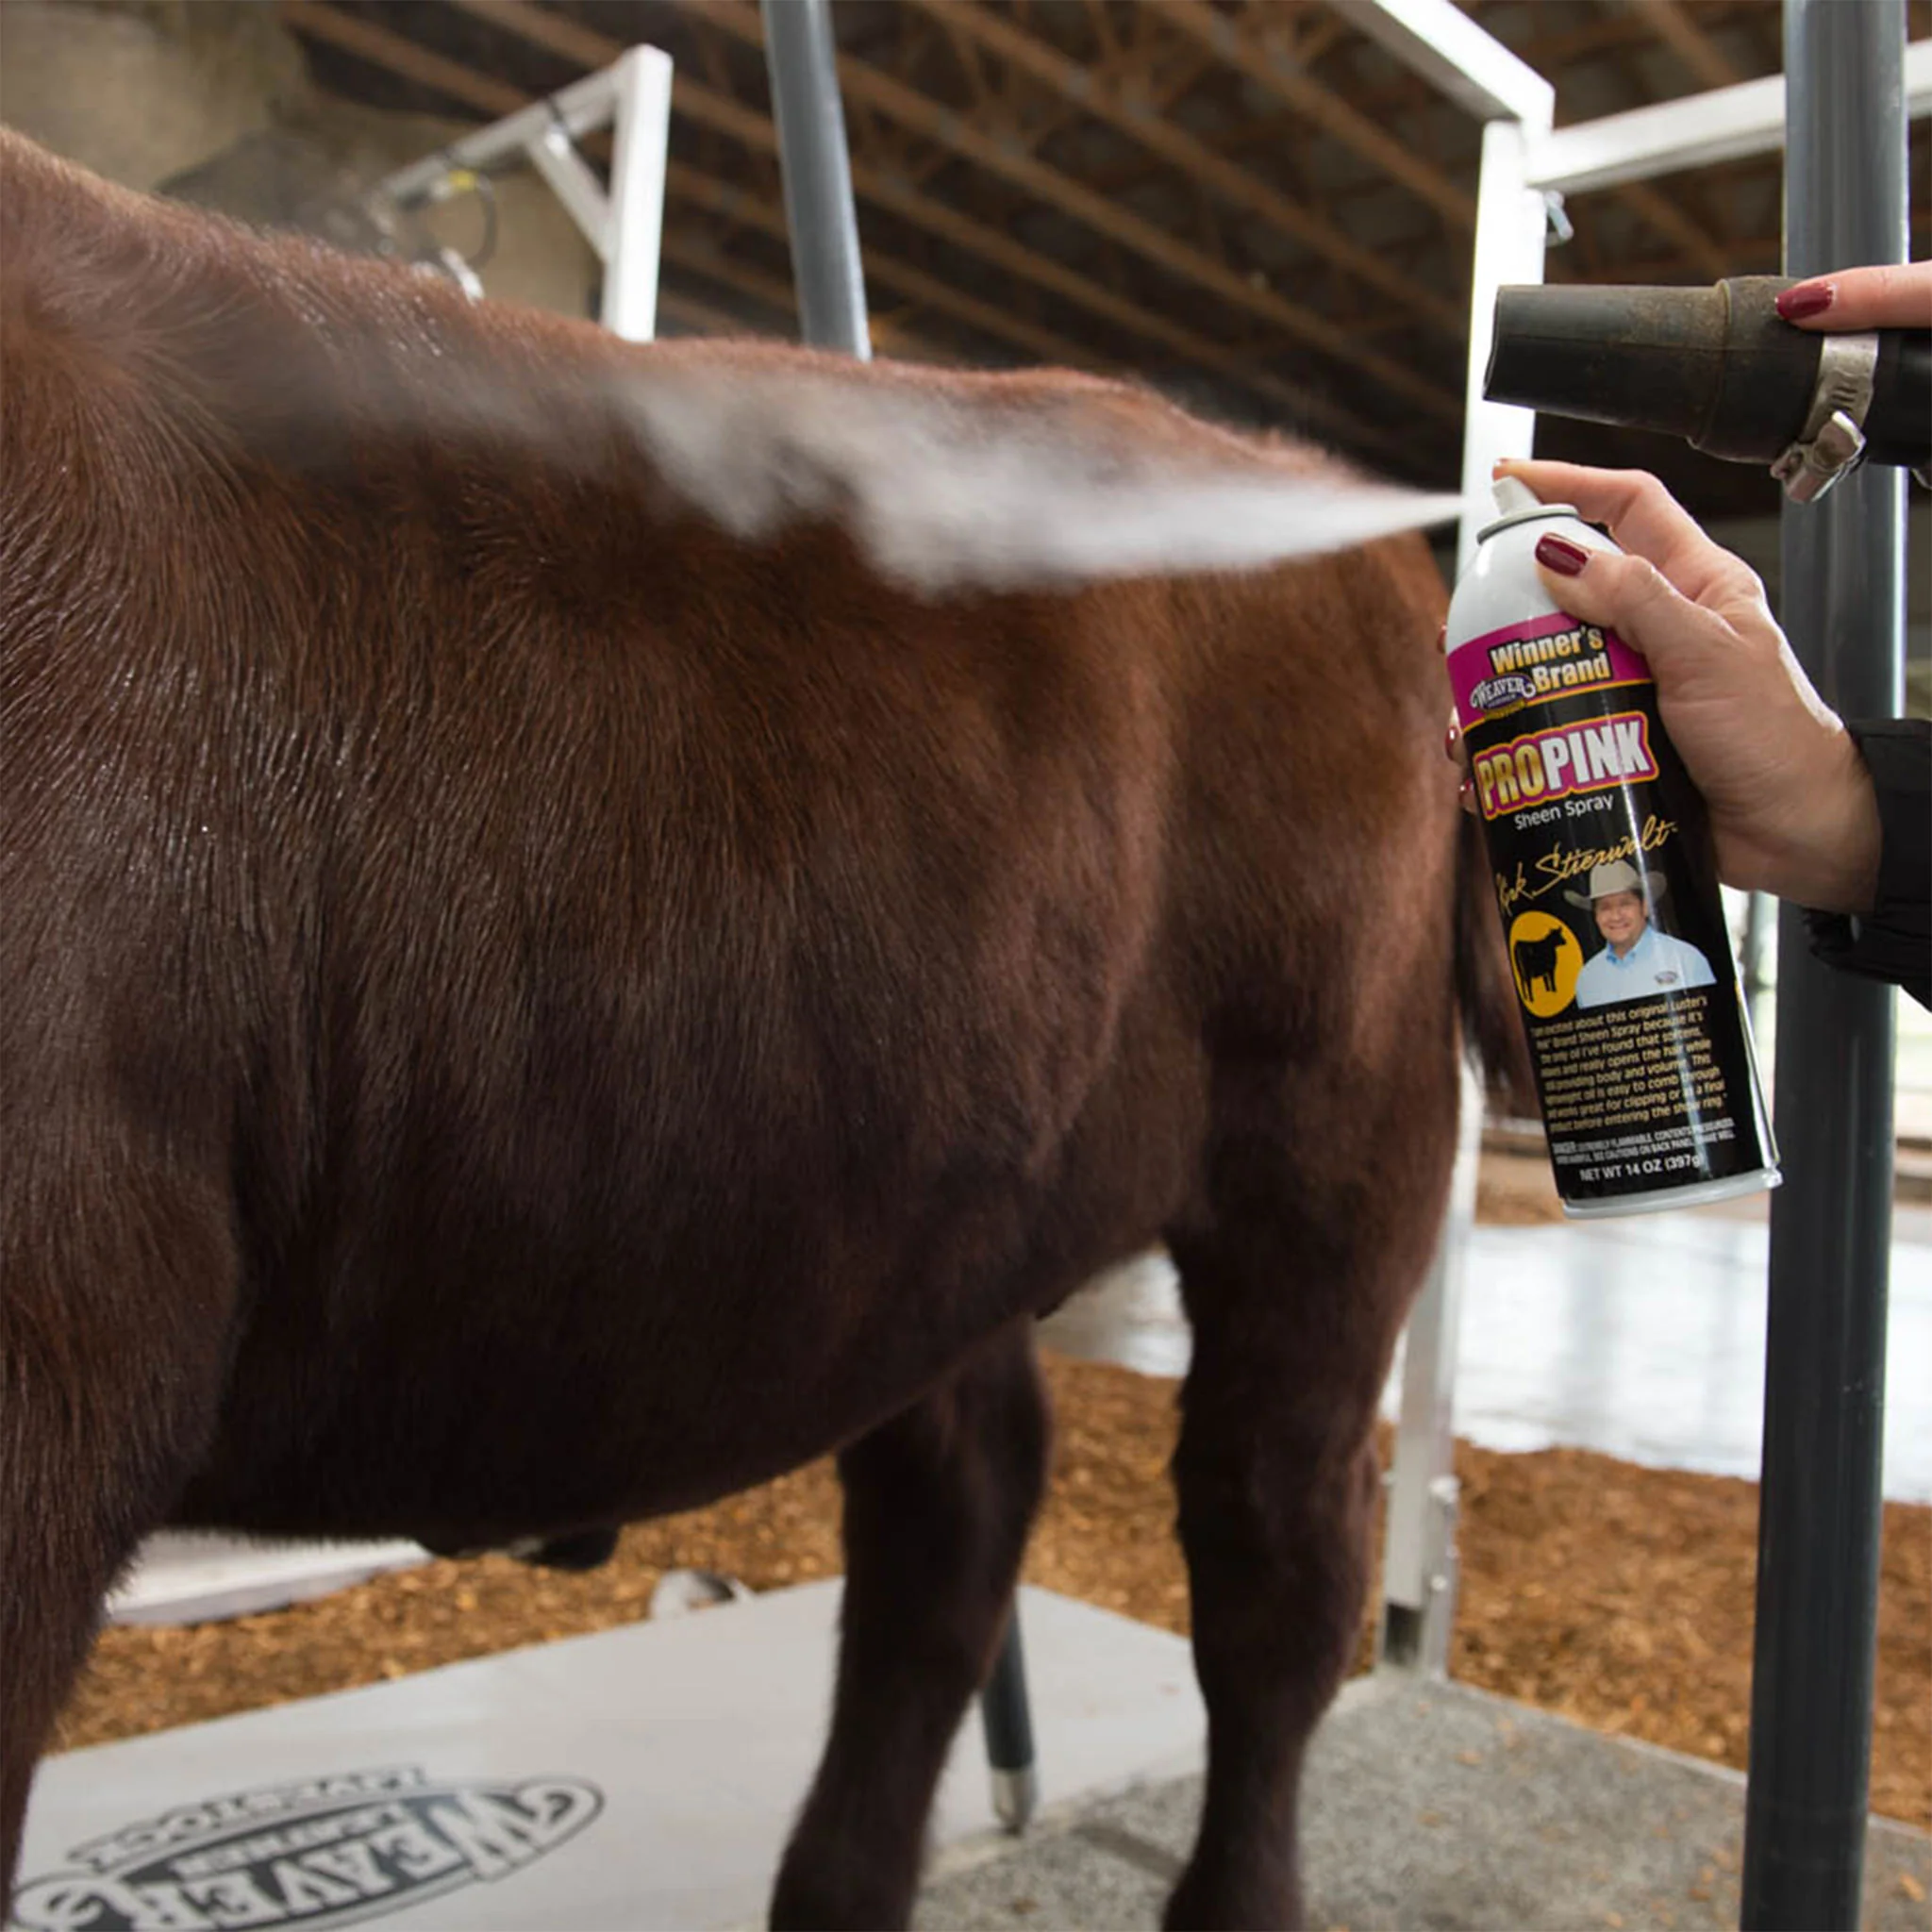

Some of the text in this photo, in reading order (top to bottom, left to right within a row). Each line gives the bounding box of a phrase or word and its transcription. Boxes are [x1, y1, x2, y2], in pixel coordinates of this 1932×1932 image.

[1491, 626, 1604, 675] Winner's
[1532, 652, 1611, 693] Brand
[1470, 676, 1537, 708] WEAVER
[1514, 794, 1614, 830] Sheen Spray
[1606, 1010, 1626, 1024] this
[1628, 1003, 1668, 1020] original
[1578, 1029, 1609, 1045] Sheen
[1610, 1024, 1641, 1039] Spray
[1642, 1015, 1687, 1032] because
[1581, 1045, 1601, 1058] I've
[1602, 1039, 1634, 1053] found
[1635, 1033, 1659, 1047] that
[1607, 1052, 1641, 1067] opens
[1641, 1048, 1661, 1061] the
[1596, 1070, 1622, 1084] body
[1624, 1066, 1645, 1079] and
[1692, 1054, 1712, 1066] This
[1606, 1098, 1623, 1111] for
[1624, 1091, 1668, 1109] clipping
[1668, 1090, 1681, 1101] or
[1704, 1077, 1726, 1092] final
[1607, 1083, 1630, 1096] easy
[1632, 1080, 1646, 1092] to
[1647, 1074, 1679, 1090] comb
[1605, 1109, 1650, 1125] entering
[1651, 1106, 1672, 1119] the
[1673, 1099, 1701, 1114] show
[1579, 1167, 1601, 1182] NET
[1602, 1164, 1622, 1178] WT
[1624, 1161, 1641, 1176] 14
[1642, 1158, 1663, 1174] OZ
[11, 1777, 606, 1932] WEAVER
